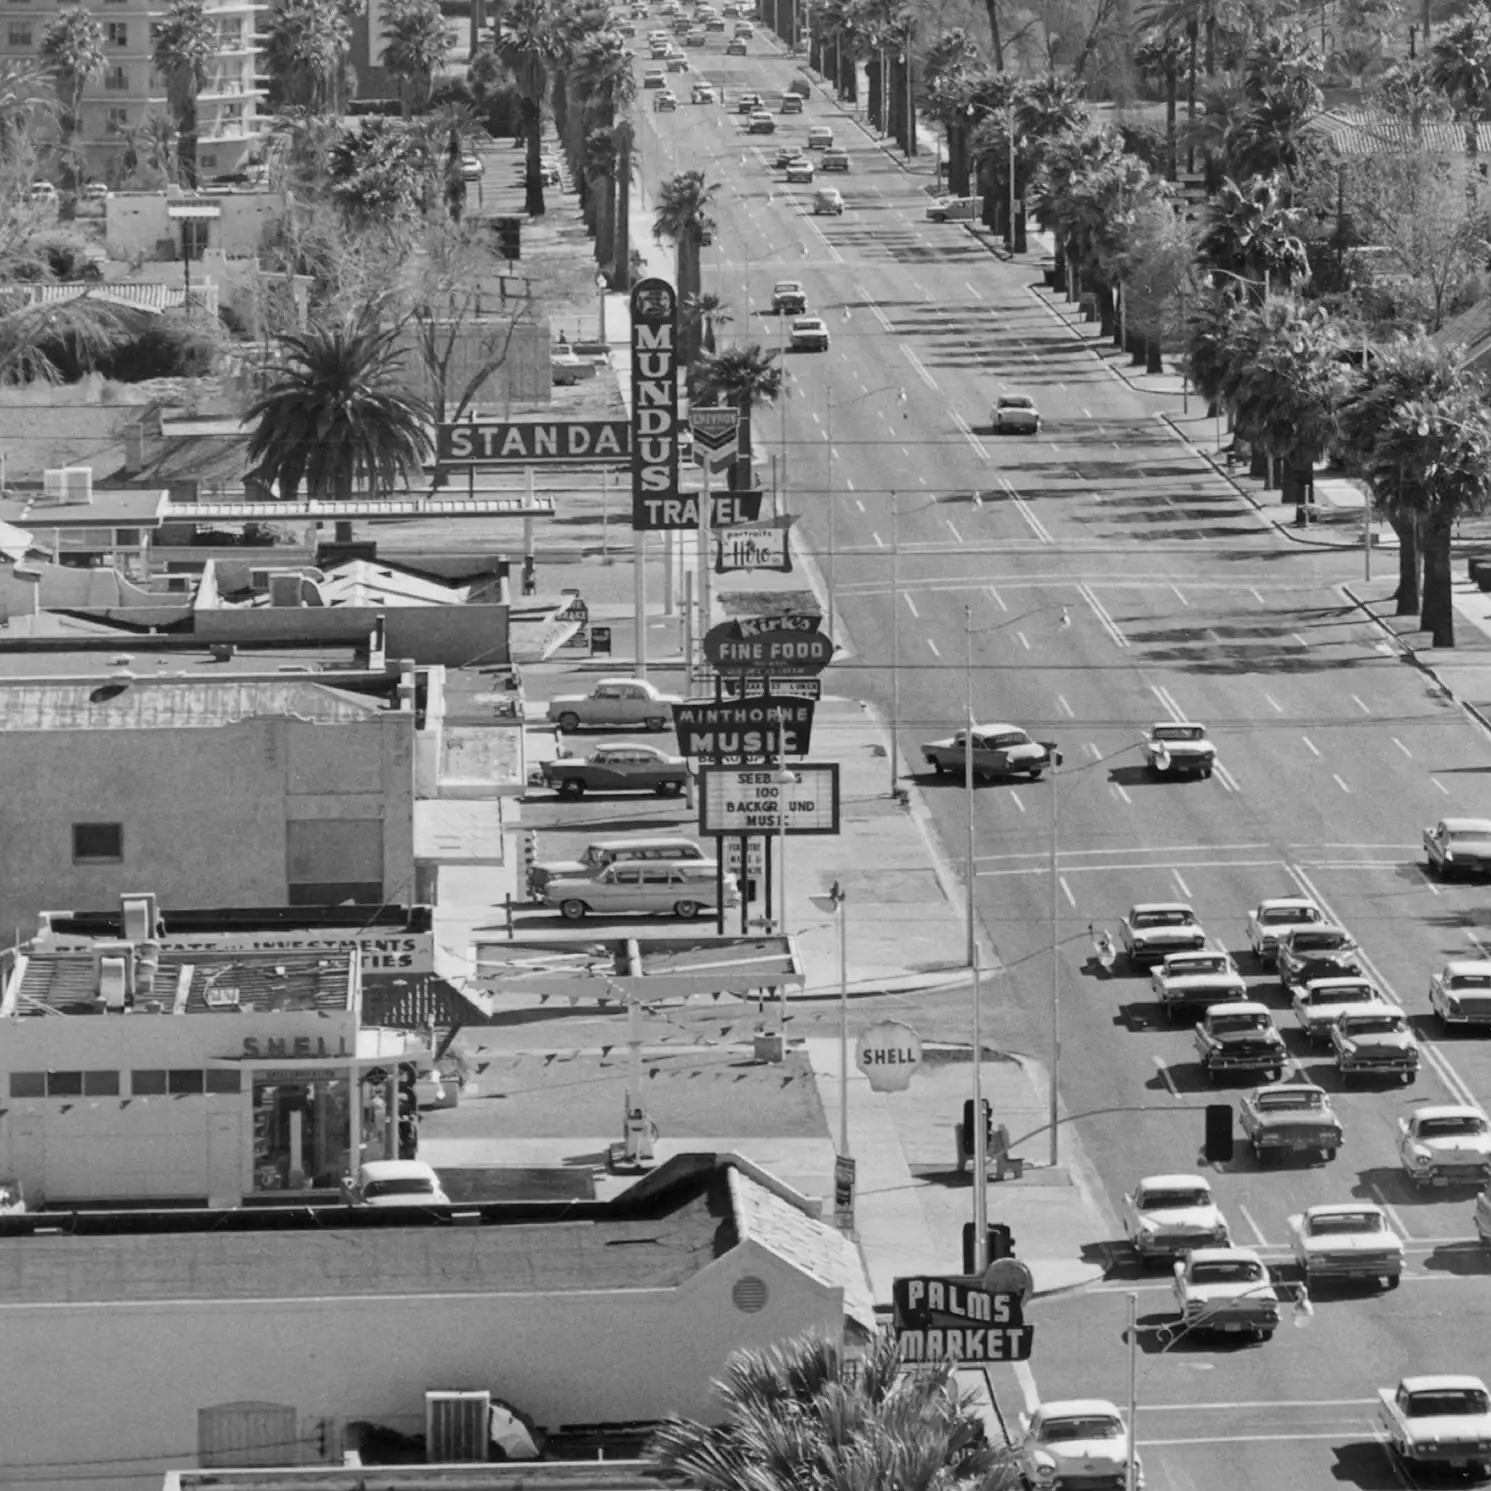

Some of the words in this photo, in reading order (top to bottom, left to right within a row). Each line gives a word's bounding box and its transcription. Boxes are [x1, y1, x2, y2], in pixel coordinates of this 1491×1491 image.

[634, 323, 674, 492] MUNDUS
[451, 425, 632, 457] STANDA
[739, 616, 811, 638] Kirk's
[719, 643, 763, 659] FINE
[770, 642, 824, 659] FOOD
[679, 707, 808, 724] MINTHORNE
[690, 731, 798, 753] MUSIC
[738, 773, 803, 784] SEEBG
[756, 788, 779, 798] 100
[726, 801, 815, 813] BACKGRUND
[243, 1036, 354, 1058] SHELL
[863, 1048, 917, 1065] SHELL
[909, 1279, 1011, 1323] PALMS
[900, 1327, 1024, 1361] MARKET
